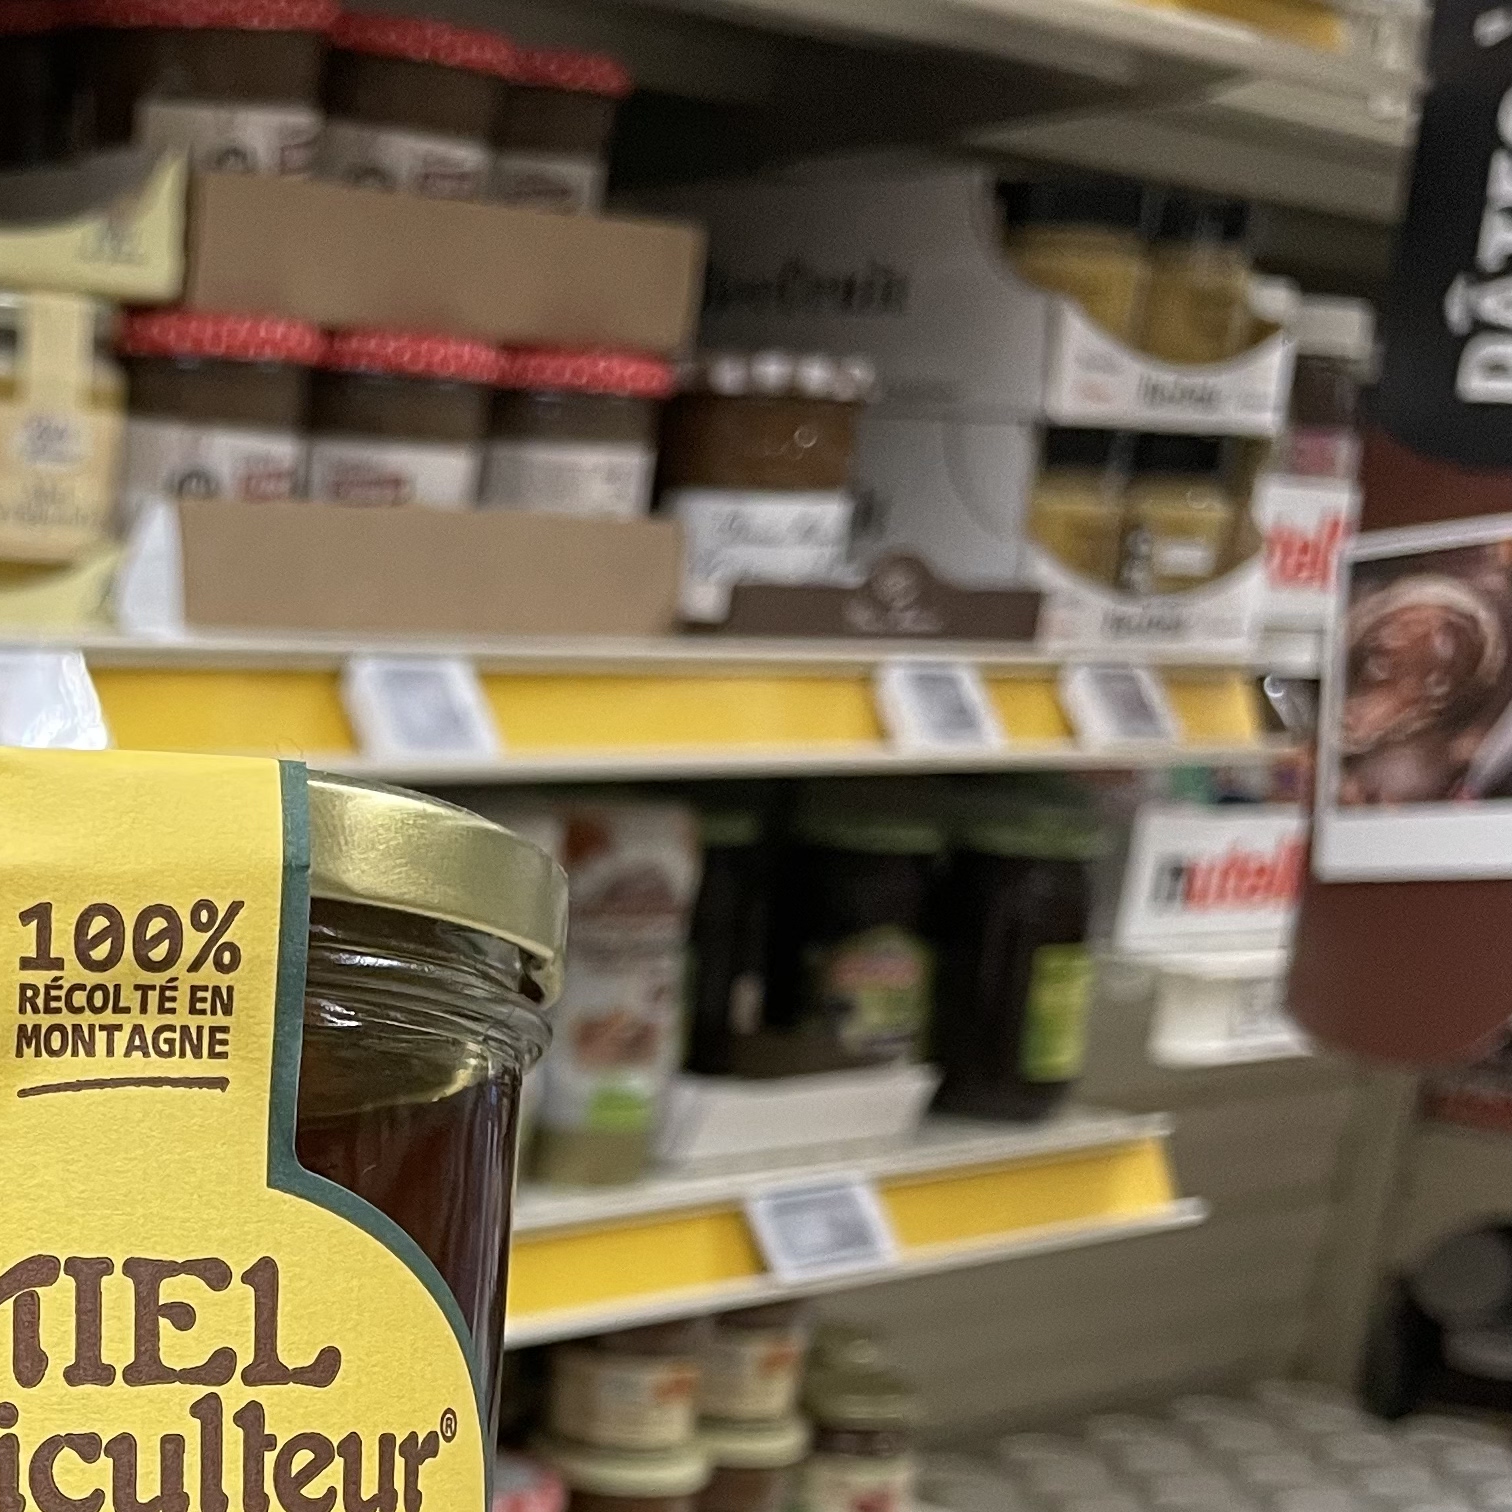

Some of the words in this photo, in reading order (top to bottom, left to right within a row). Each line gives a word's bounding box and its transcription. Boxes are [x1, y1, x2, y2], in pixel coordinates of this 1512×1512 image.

[18, 899, 245, 975] 100%
[18, 975, 180, 1016] RÉCOLTÉ
[188, 984, 235, 1017] EN
[14, 1022, 231, 1060] MONTAGNE
